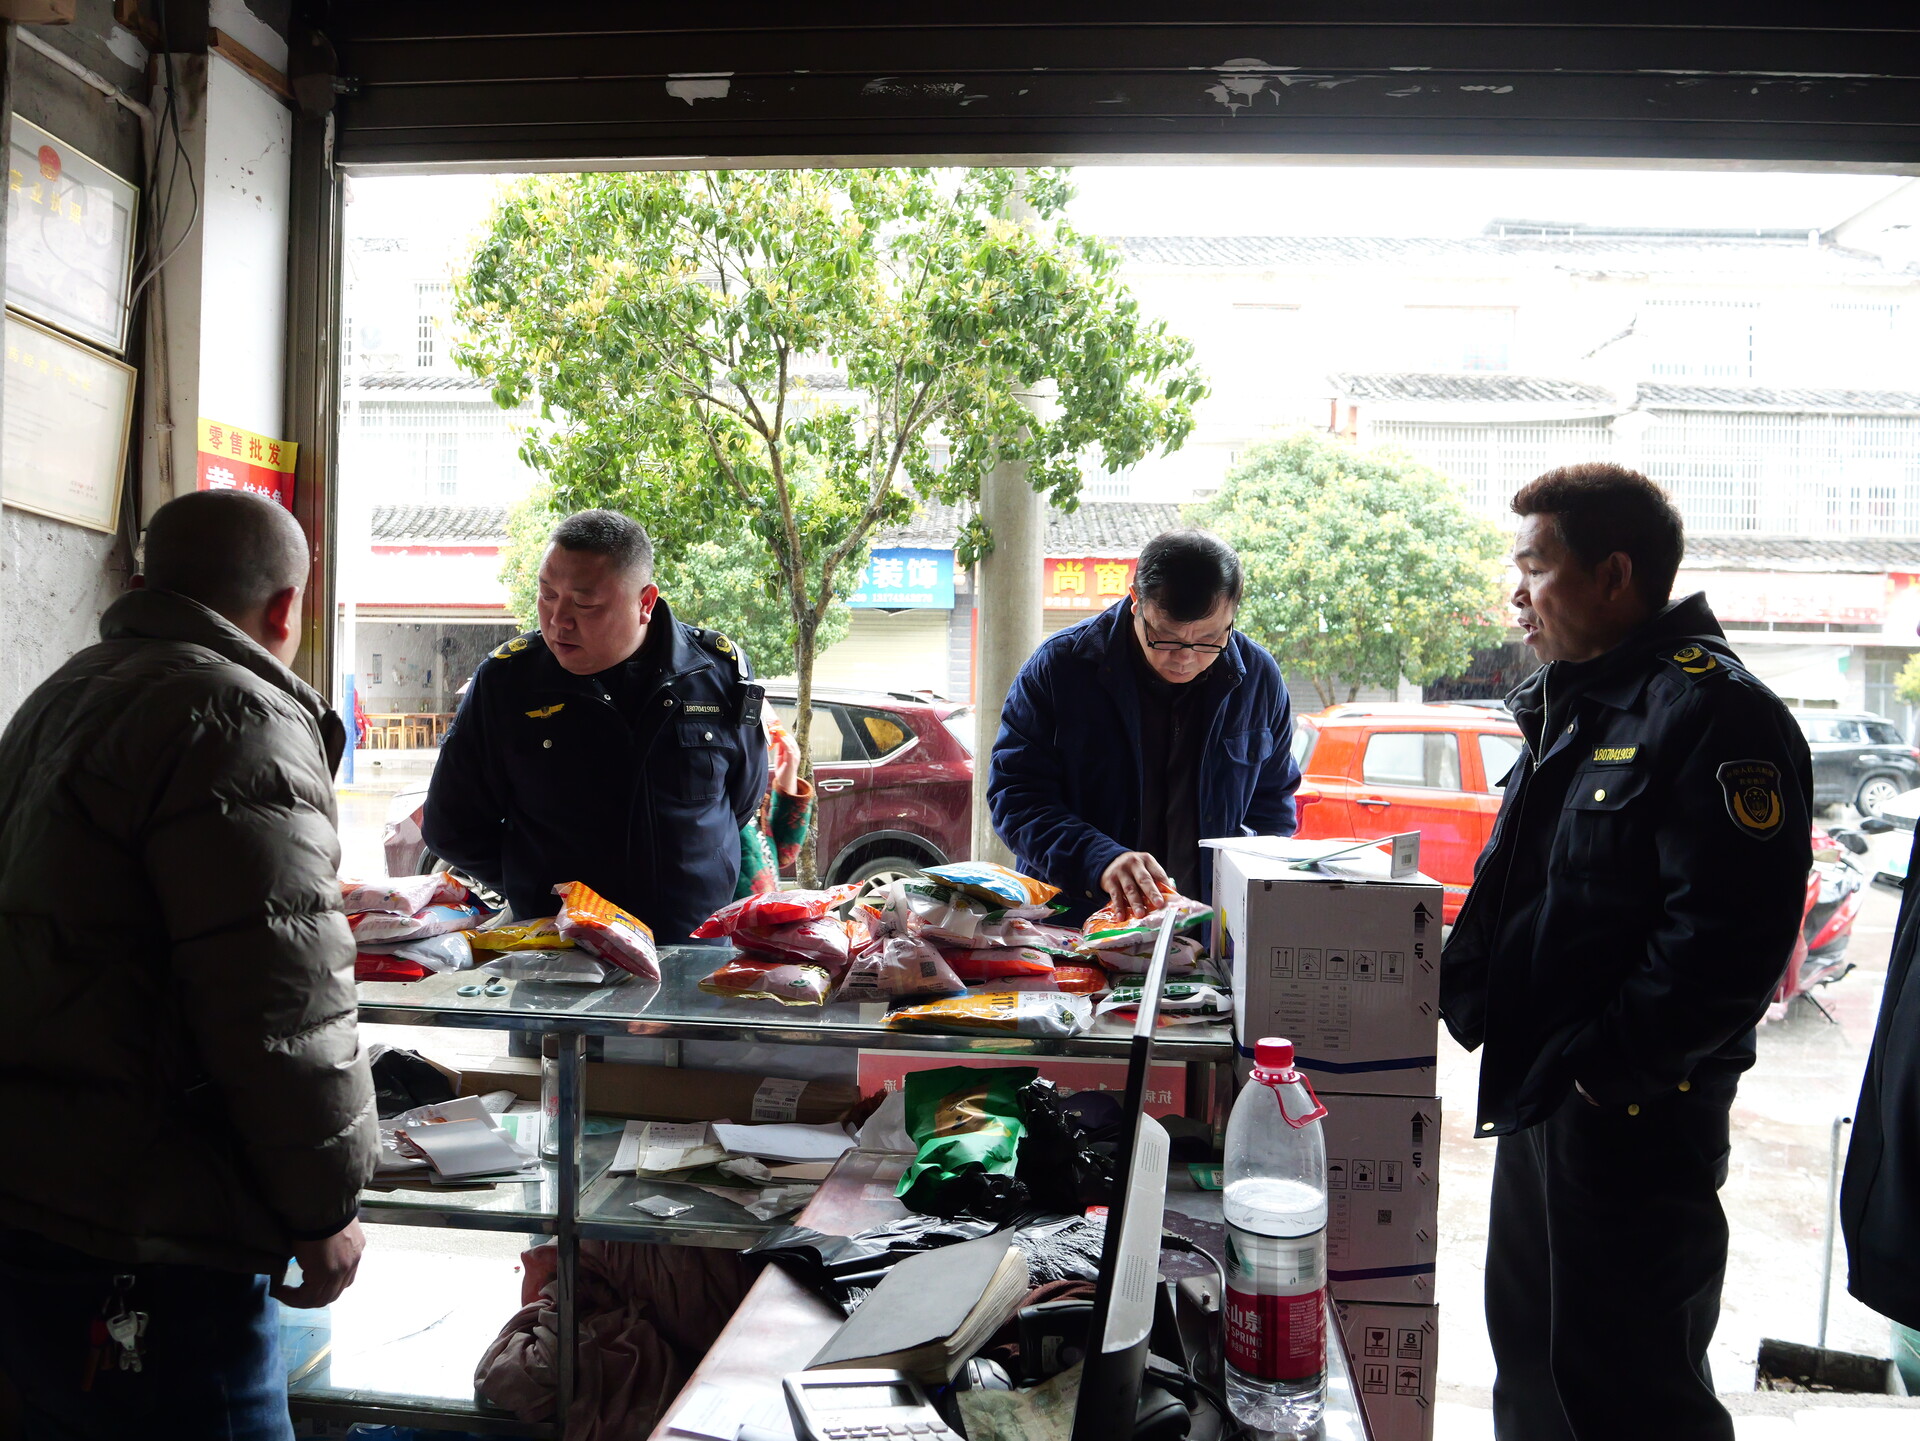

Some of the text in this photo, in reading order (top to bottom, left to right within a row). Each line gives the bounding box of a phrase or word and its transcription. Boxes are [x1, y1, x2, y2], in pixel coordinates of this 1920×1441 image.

[209, 425, 281, 466] 零售批发
[1053, 561, 1130, 596] 尚窗
[1414, 942, 1424, 959] UP
[1412, 1152, 1422, 1169] UP
[1231, 1325, 1262, 1348] SPRING
[1406, 1332, 1416, 1344] 8
